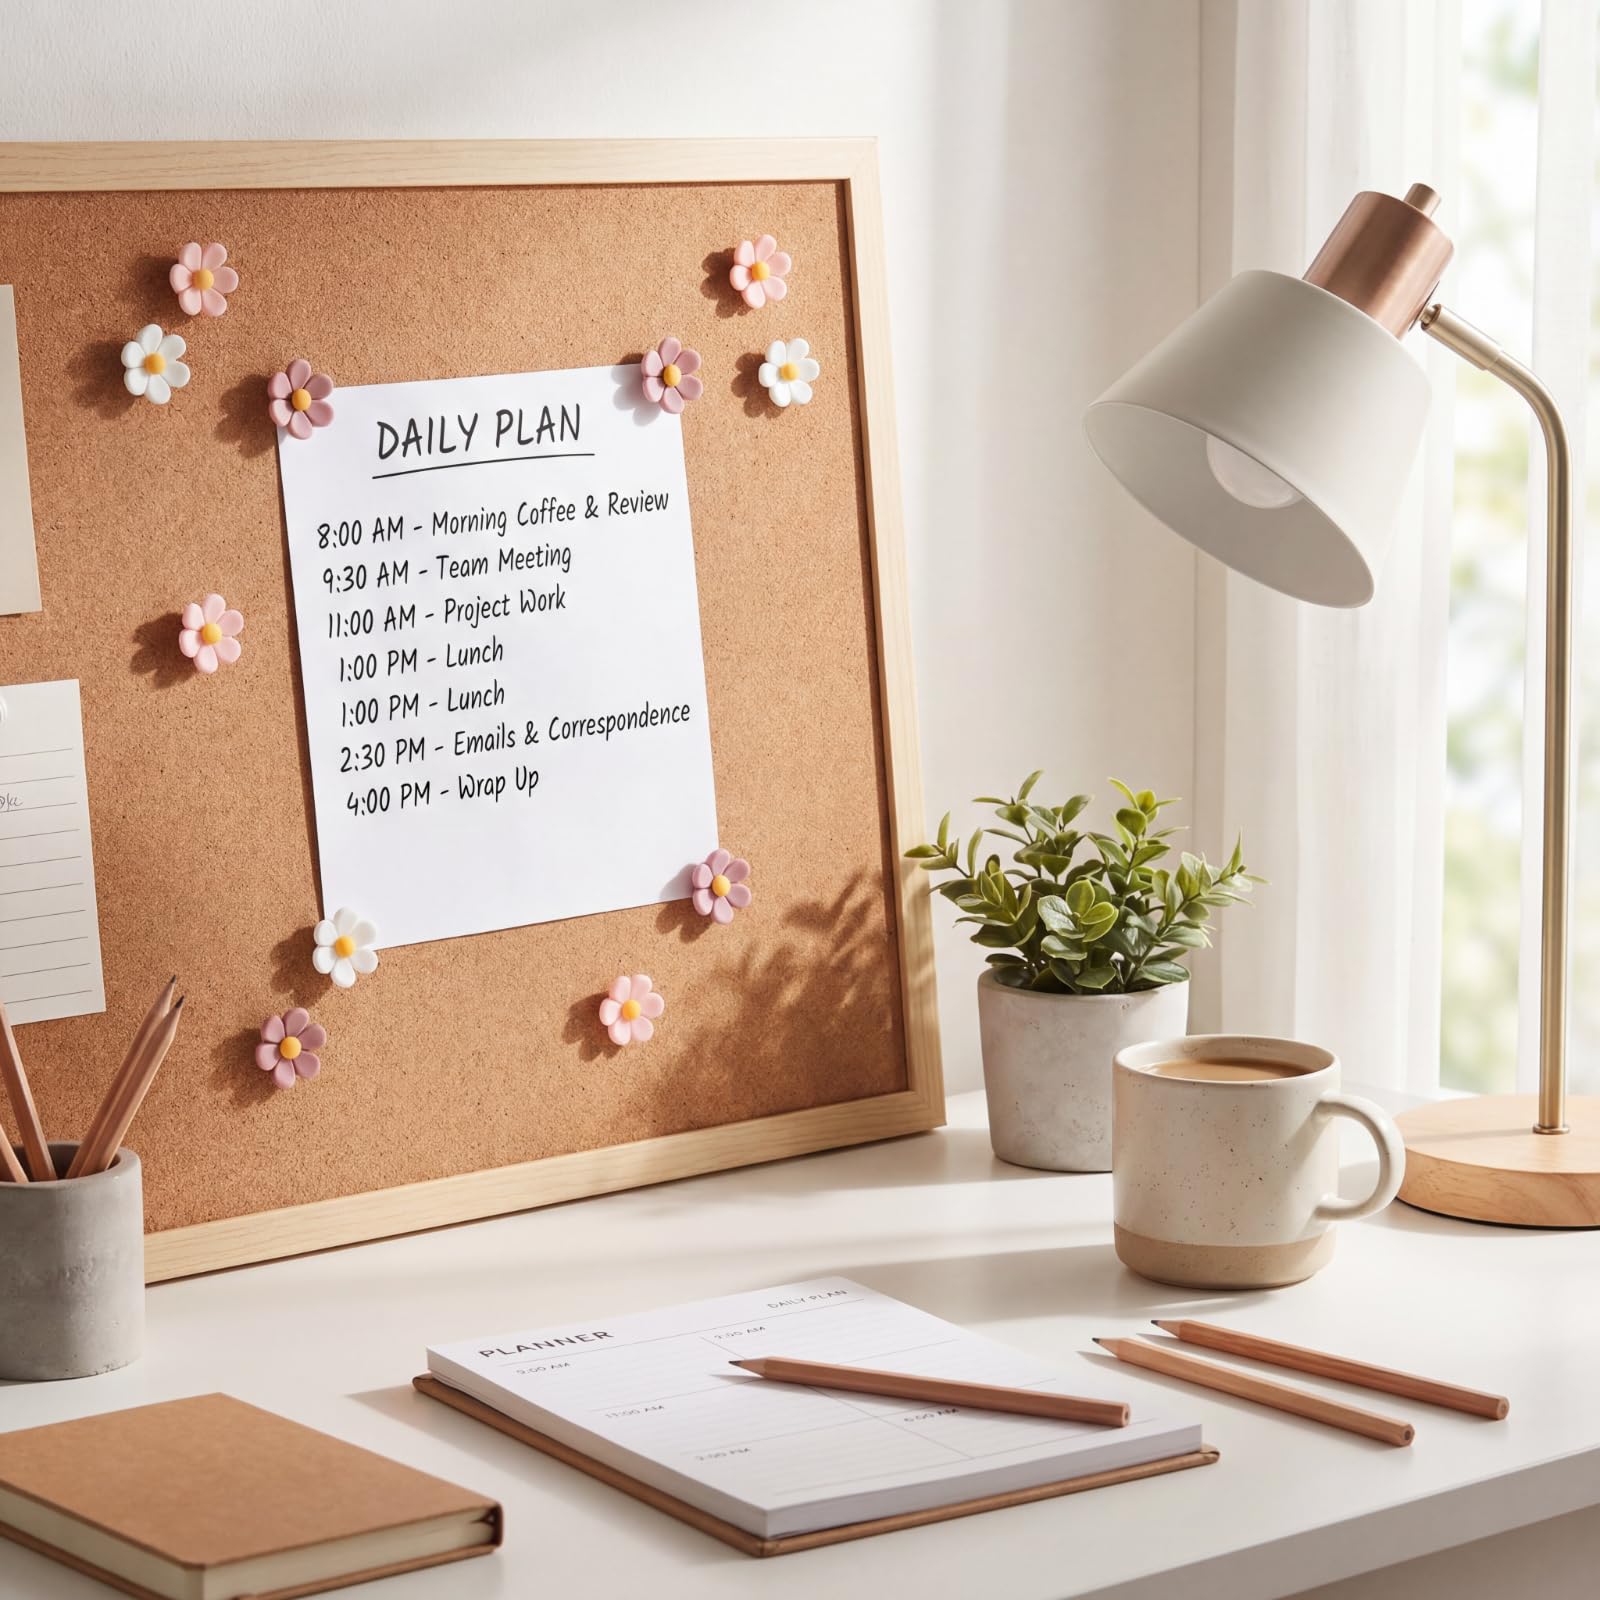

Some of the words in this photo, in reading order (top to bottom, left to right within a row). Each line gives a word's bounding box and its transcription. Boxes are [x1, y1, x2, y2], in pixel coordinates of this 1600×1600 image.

[376, 412, 479, 460] DAILY
[495, 403, 581, 449] PLAN
[316, 519, 363, 550] 8:00
[372, 515, 404, 544] AM
[432, 506, 507, 538] Morning
[517, 496, 576, 527] Coffee
[584, 494, 599, 520] &
[608, 490, 669, 516] Review
[322, 564, 367, 594] 9:30
[376, 559, 409, 588] AM
[435, 554, 489, 580] Team
[498, 543, 572, 574] Meeting
[328, 608, 374, 639] 11:00
[383, 603, 416, 633] AM
[444, 594, 511, 629] Project
[519, 583, 566, 614] Work
[340, 653, 377, 683] 1:00
[387, 647, 418, 677] PM
[446, 634, 504, 668] Lunch
[342, 697, 379, 728] 1:00
[389, 692, 419, 721] PM
[447, 678, 505, 712] Lunch
[340, 743, 386, 773] 2:30
[395, 736, 425, 765] PM
[454, 721, 516, 756] Emails
[524, 720, 540, 746] &
[548, 700, 691, 742] Correspondence
[346, 786, 391, 817] 4:00
[400, 780, 431, 809] PM
[458, 773, 506, 803] Wrap
[515, 765, 539, 798] Up
[767, 1298, 805, 1309] DAILY
[809, 1290, 847, 1300] PLAN
[479, 1331, 614, 1358] PLANNER
